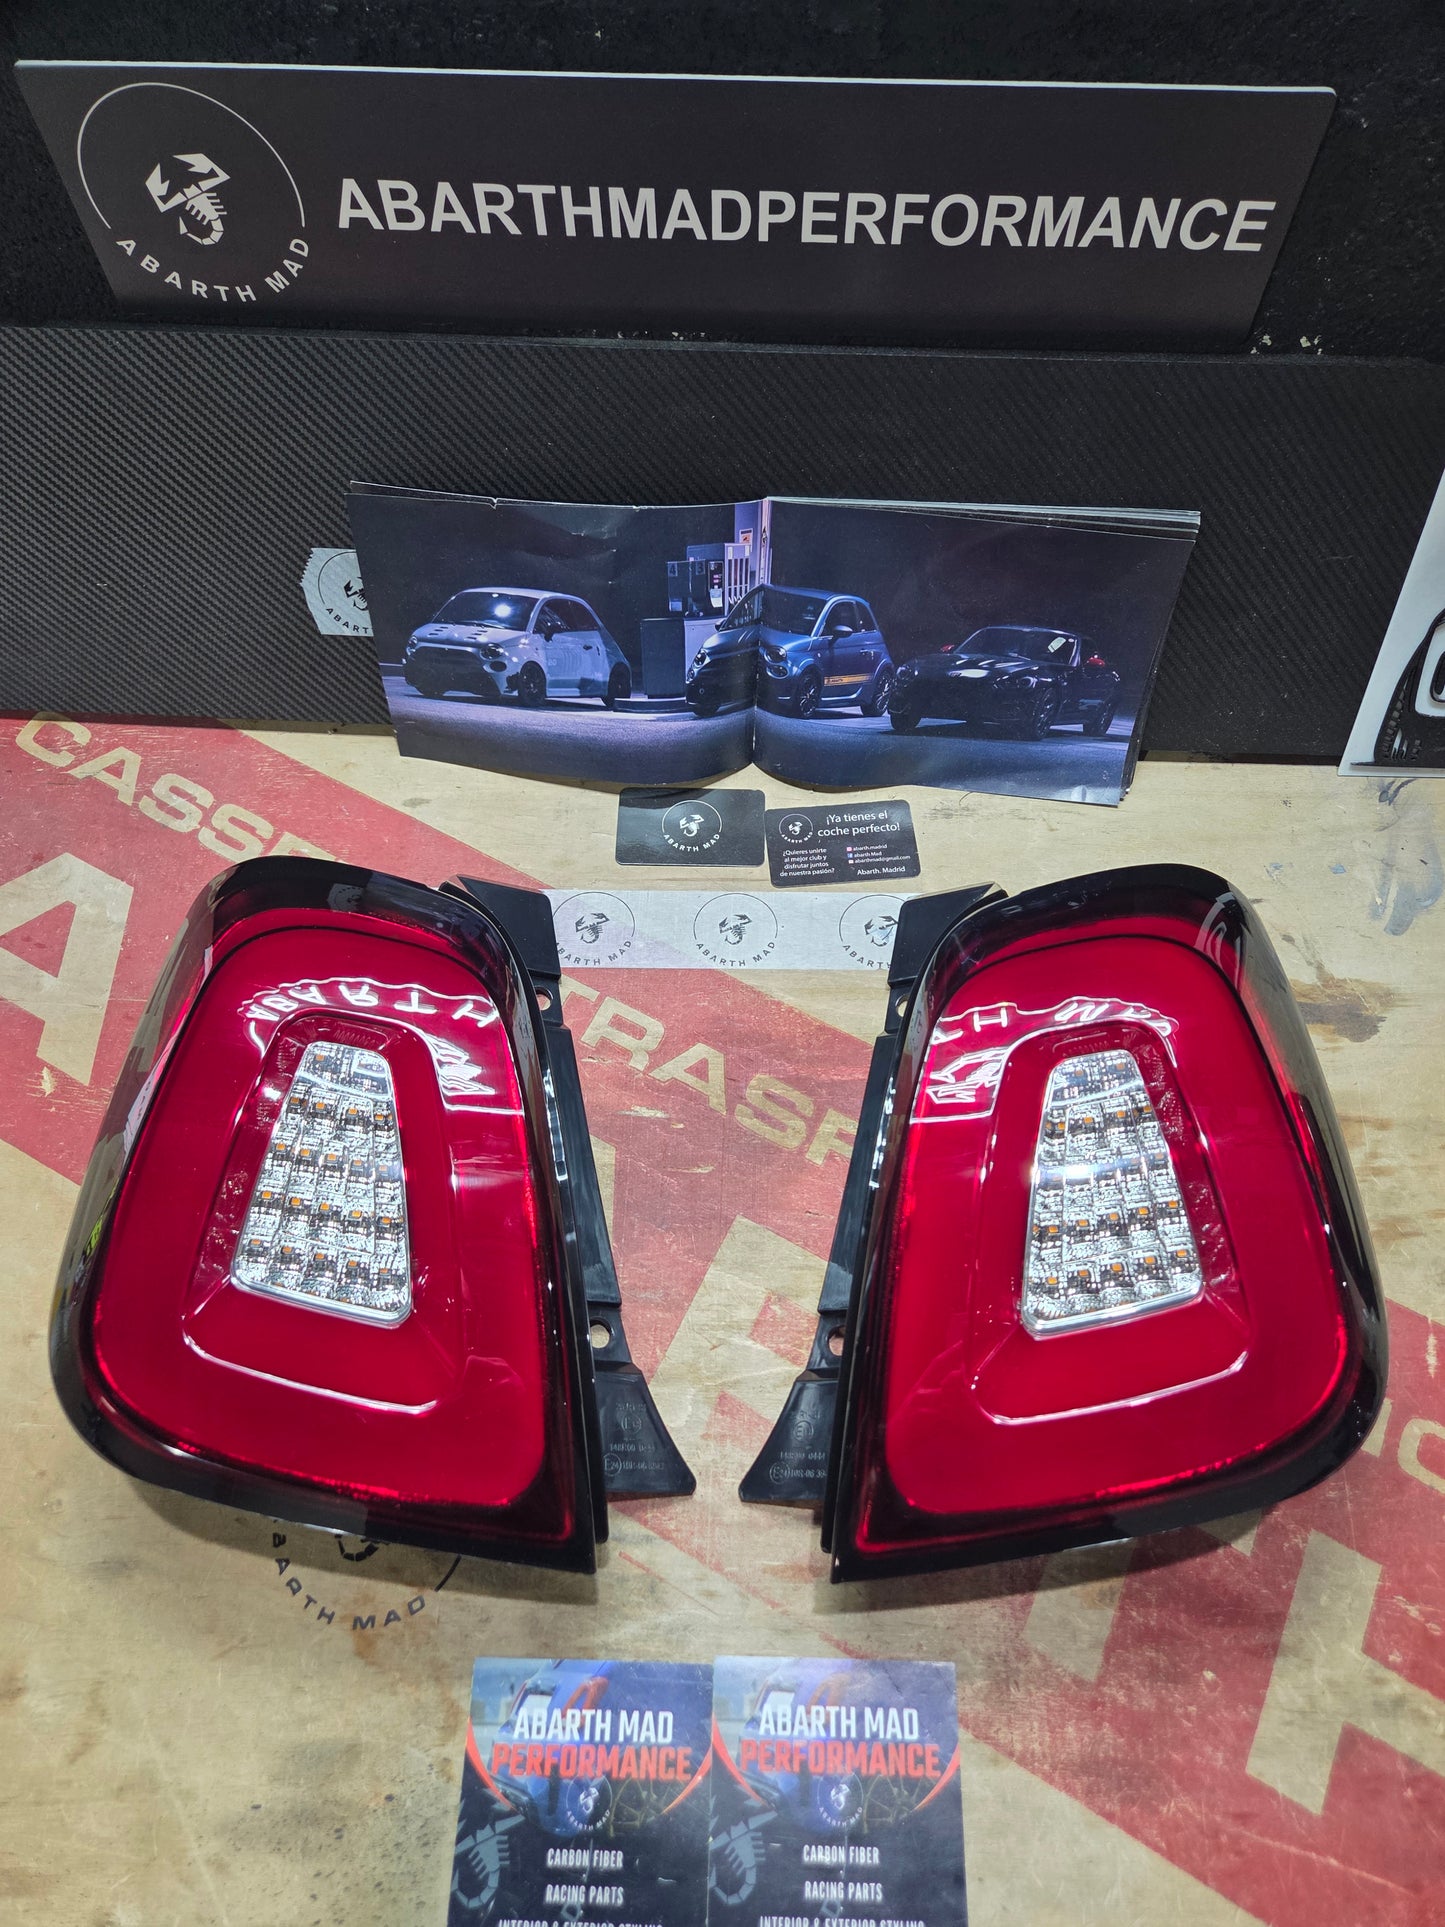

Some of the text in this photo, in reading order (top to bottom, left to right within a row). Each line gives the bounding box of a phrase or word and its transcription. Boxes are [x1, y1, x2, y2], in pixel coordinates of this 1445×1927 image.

[337, 177, 1277, 253] ABARTHMADPERFORMANCE
[115, 238, 309, 303] ABARTH MAD
[325, 607, 369, 635] ABART
[15, 711, 348, 863] CASS
[817, 822, 900, 837] coche perfecto!
[826, 810, 888, 826] ¡Ya tienes el
[663, 833, 720, 852] ABARTH MAD
[779, 866, 835, 877] de nuestra pasión?
[809, 861, 829, 869] juntos
[882, 865, 906, 874] Madrid
[608, 941, 632, 962] MAD
[695, 942, 775, 968] ABARTH MAD
[272, 1530, 426, 1631] BARTH MAD
[512, 1708, 674, 1744] ABARTH MAD
[759, 1703, 920, 1741] ABARTH MAD
[491, 1742, 693, 1781] PERFORMANCE
[740, 1738, 942, 1779] PERFORMANCE
[546, 1847, 625, 1870] CARBON FIBER
[802, 1844, 880, 1866] CARBON FIBER
[544, 1883, 625, 1907] RACING PARTS
[804, 1880, 884, 1904] RACING PARTS
